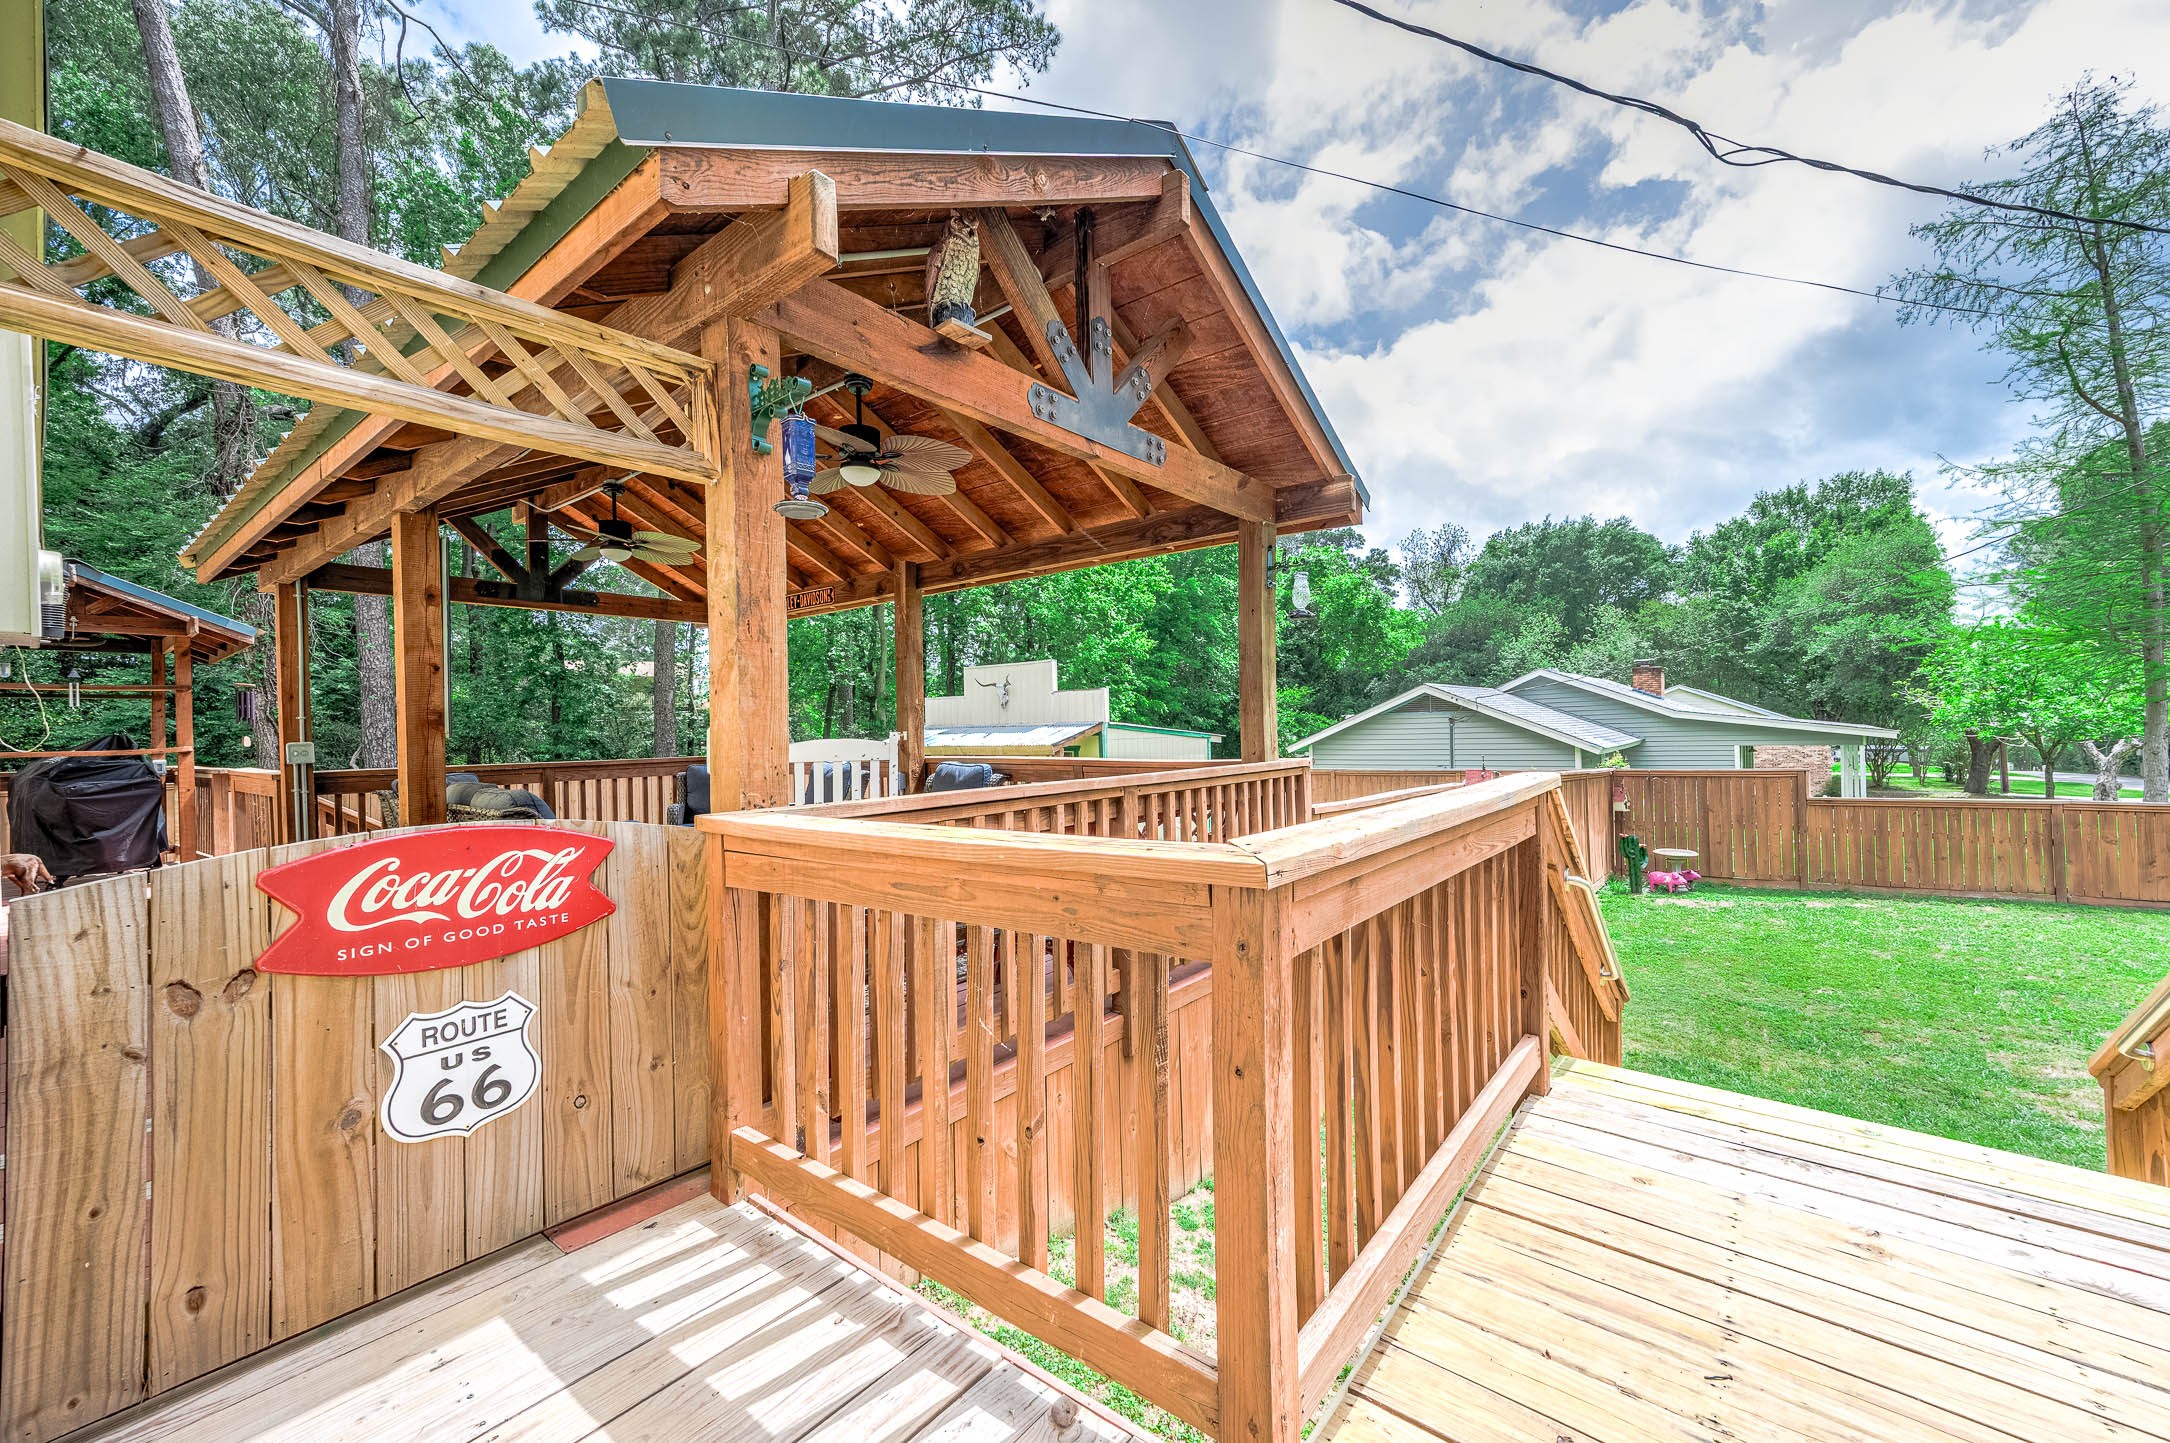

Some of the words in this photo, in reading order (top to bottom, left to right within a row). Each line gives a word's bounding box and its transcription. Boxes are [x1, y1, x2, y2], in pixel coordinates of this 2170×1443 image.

[787, 590, 828, 609] LEY-DAVIDSON
[327, 846, 585, 932] Coca-Cola
[337, 941, 393, 961] SIGN
[405, 935, 433, 949] OF
[443, 924, 505, 943] GOOD
[514, 912, 570, 931] TASTE
[421, 1008, 508, 1048] ROUTE
[440, 1046, 492, 1071] US
[420, 1063, 512, 1126] 66
